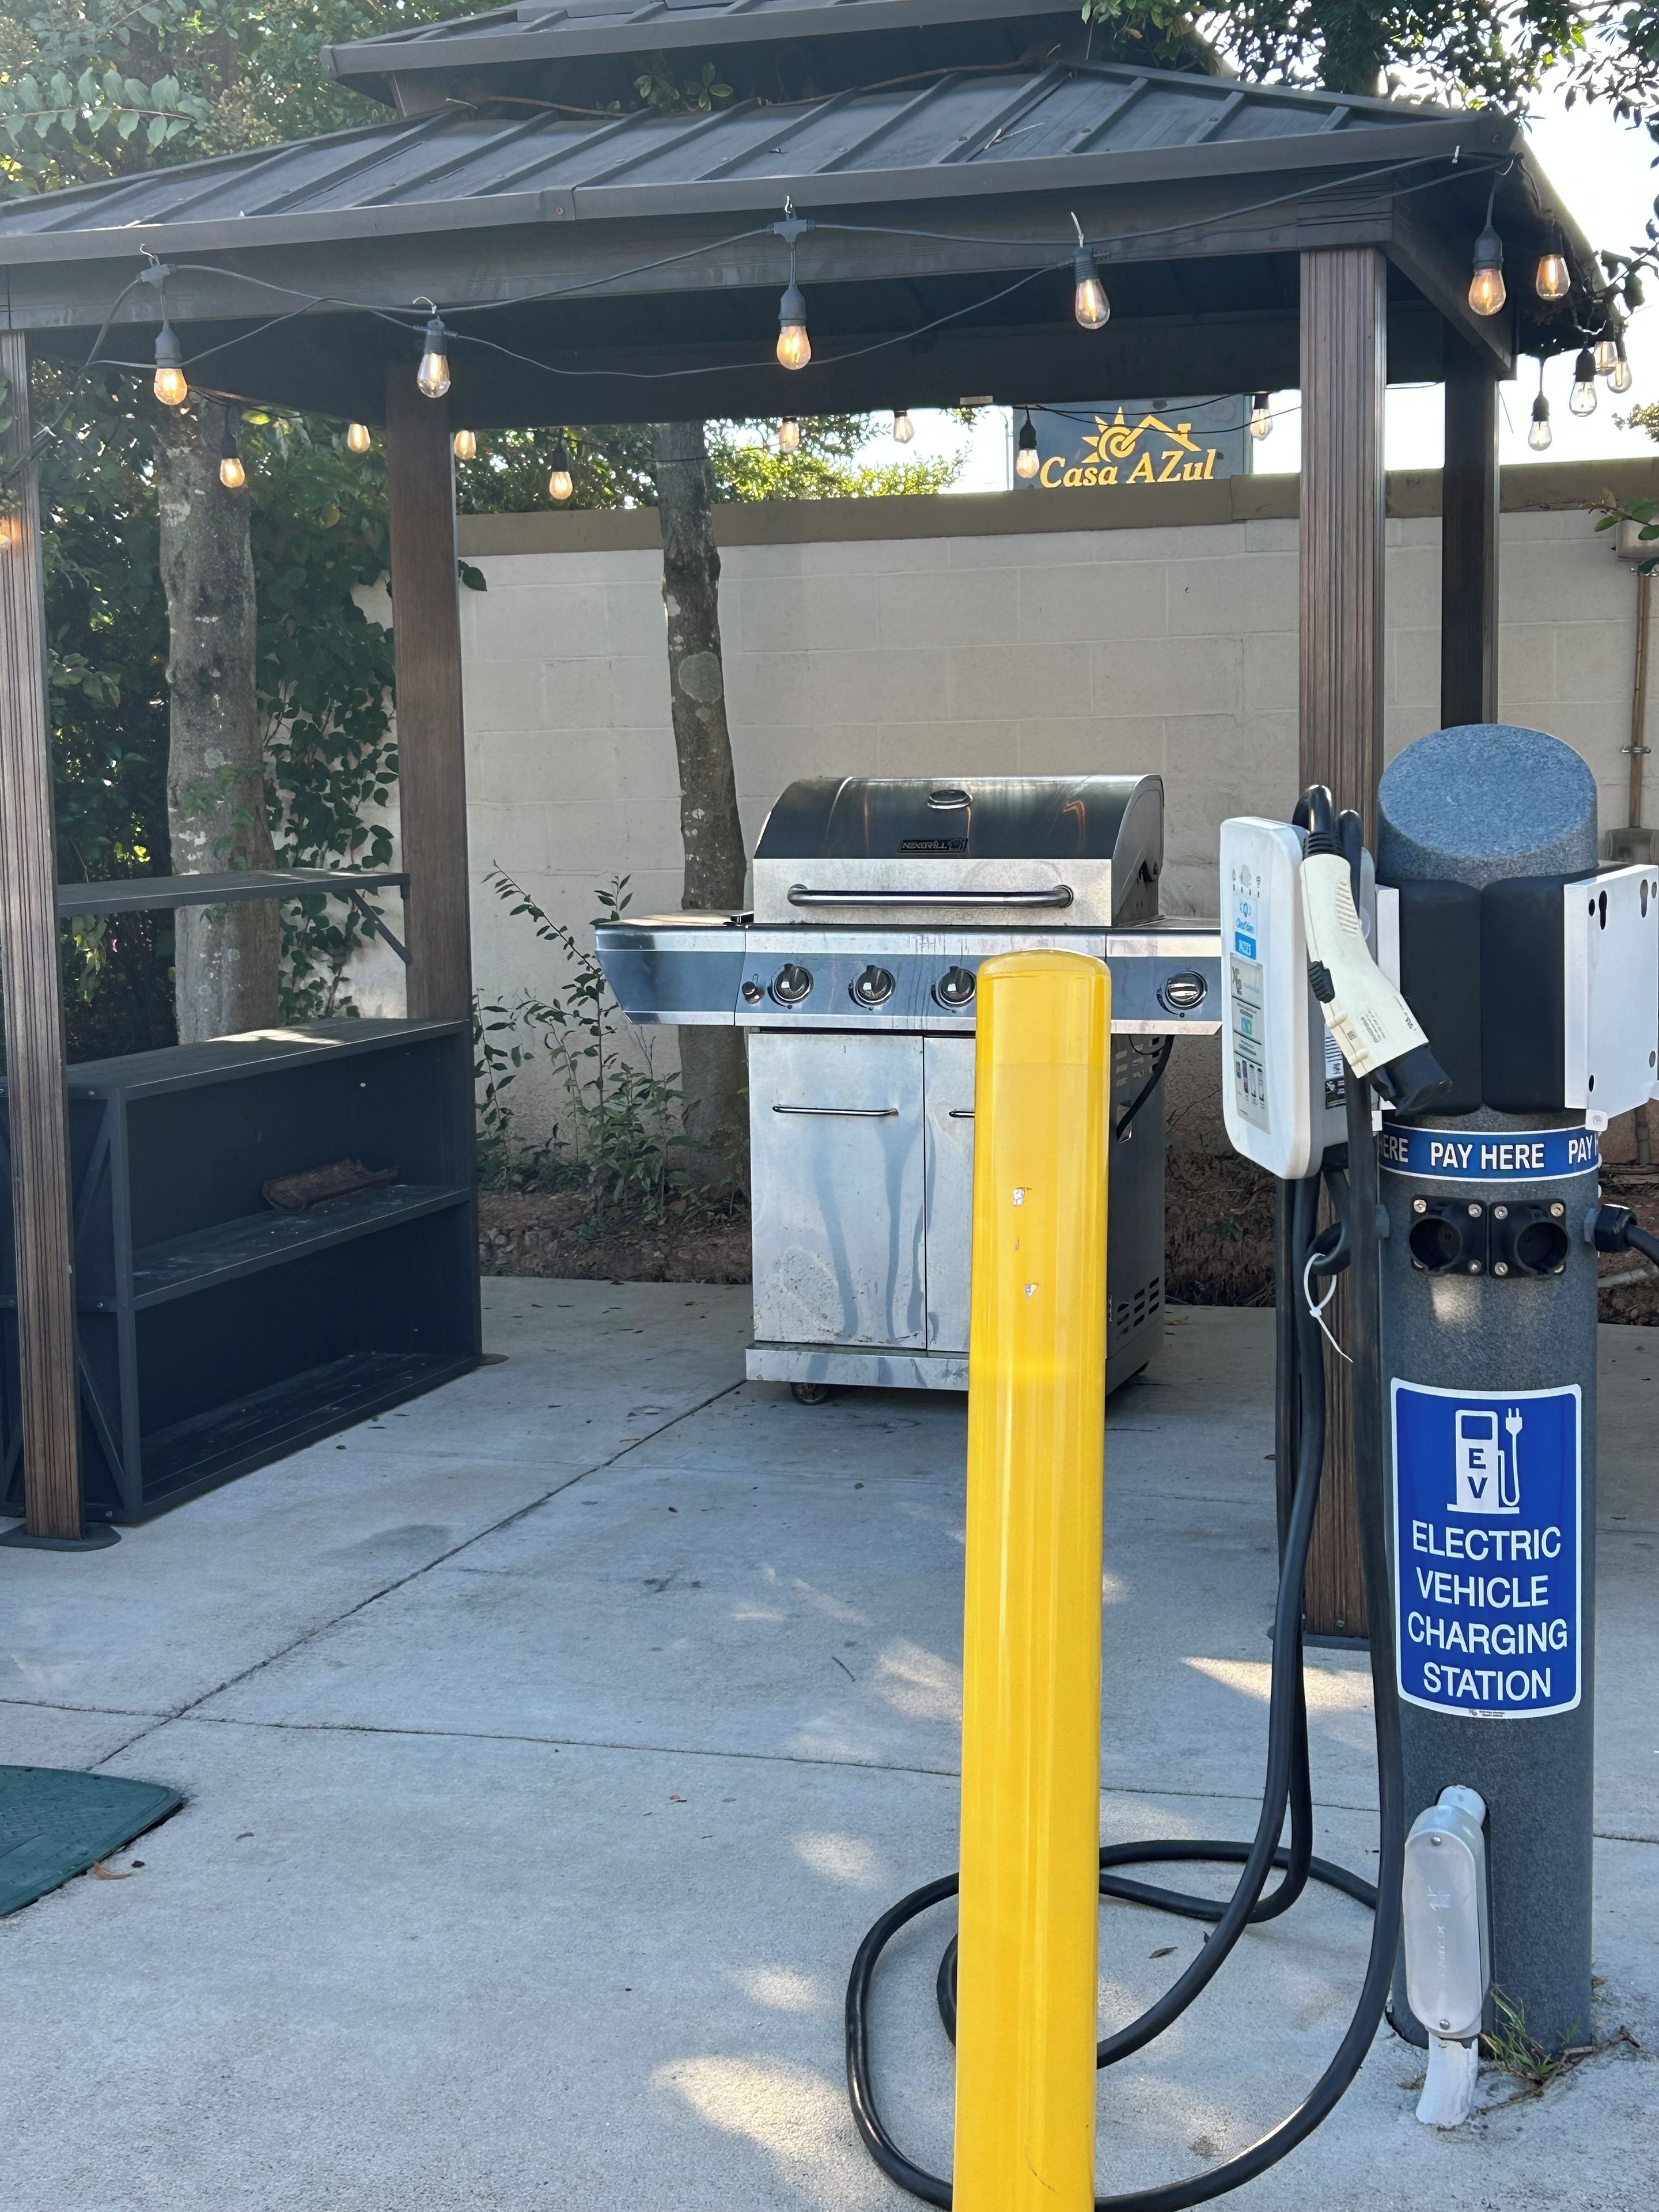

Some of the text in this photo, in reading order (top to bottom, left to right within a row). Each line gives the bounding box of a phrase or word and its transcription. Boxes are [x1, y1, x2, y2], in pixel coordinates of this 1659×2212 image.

[1039, 448, 1217, 488] Casa AZul
[1430, 1142, 1473, 1169] PAY
[1481, 1143, 1545, 1170] HERE
[1569, 1135, 1593, 1164] PAY
[1412, 1519, 1562, 1561] ELECTRIC
[1416, 1566, 1550, 1608] VEHICLE
[1408, 1611, 1568, 1655] CHARGING
[1423, 1661, 1551, 1702] STATION
